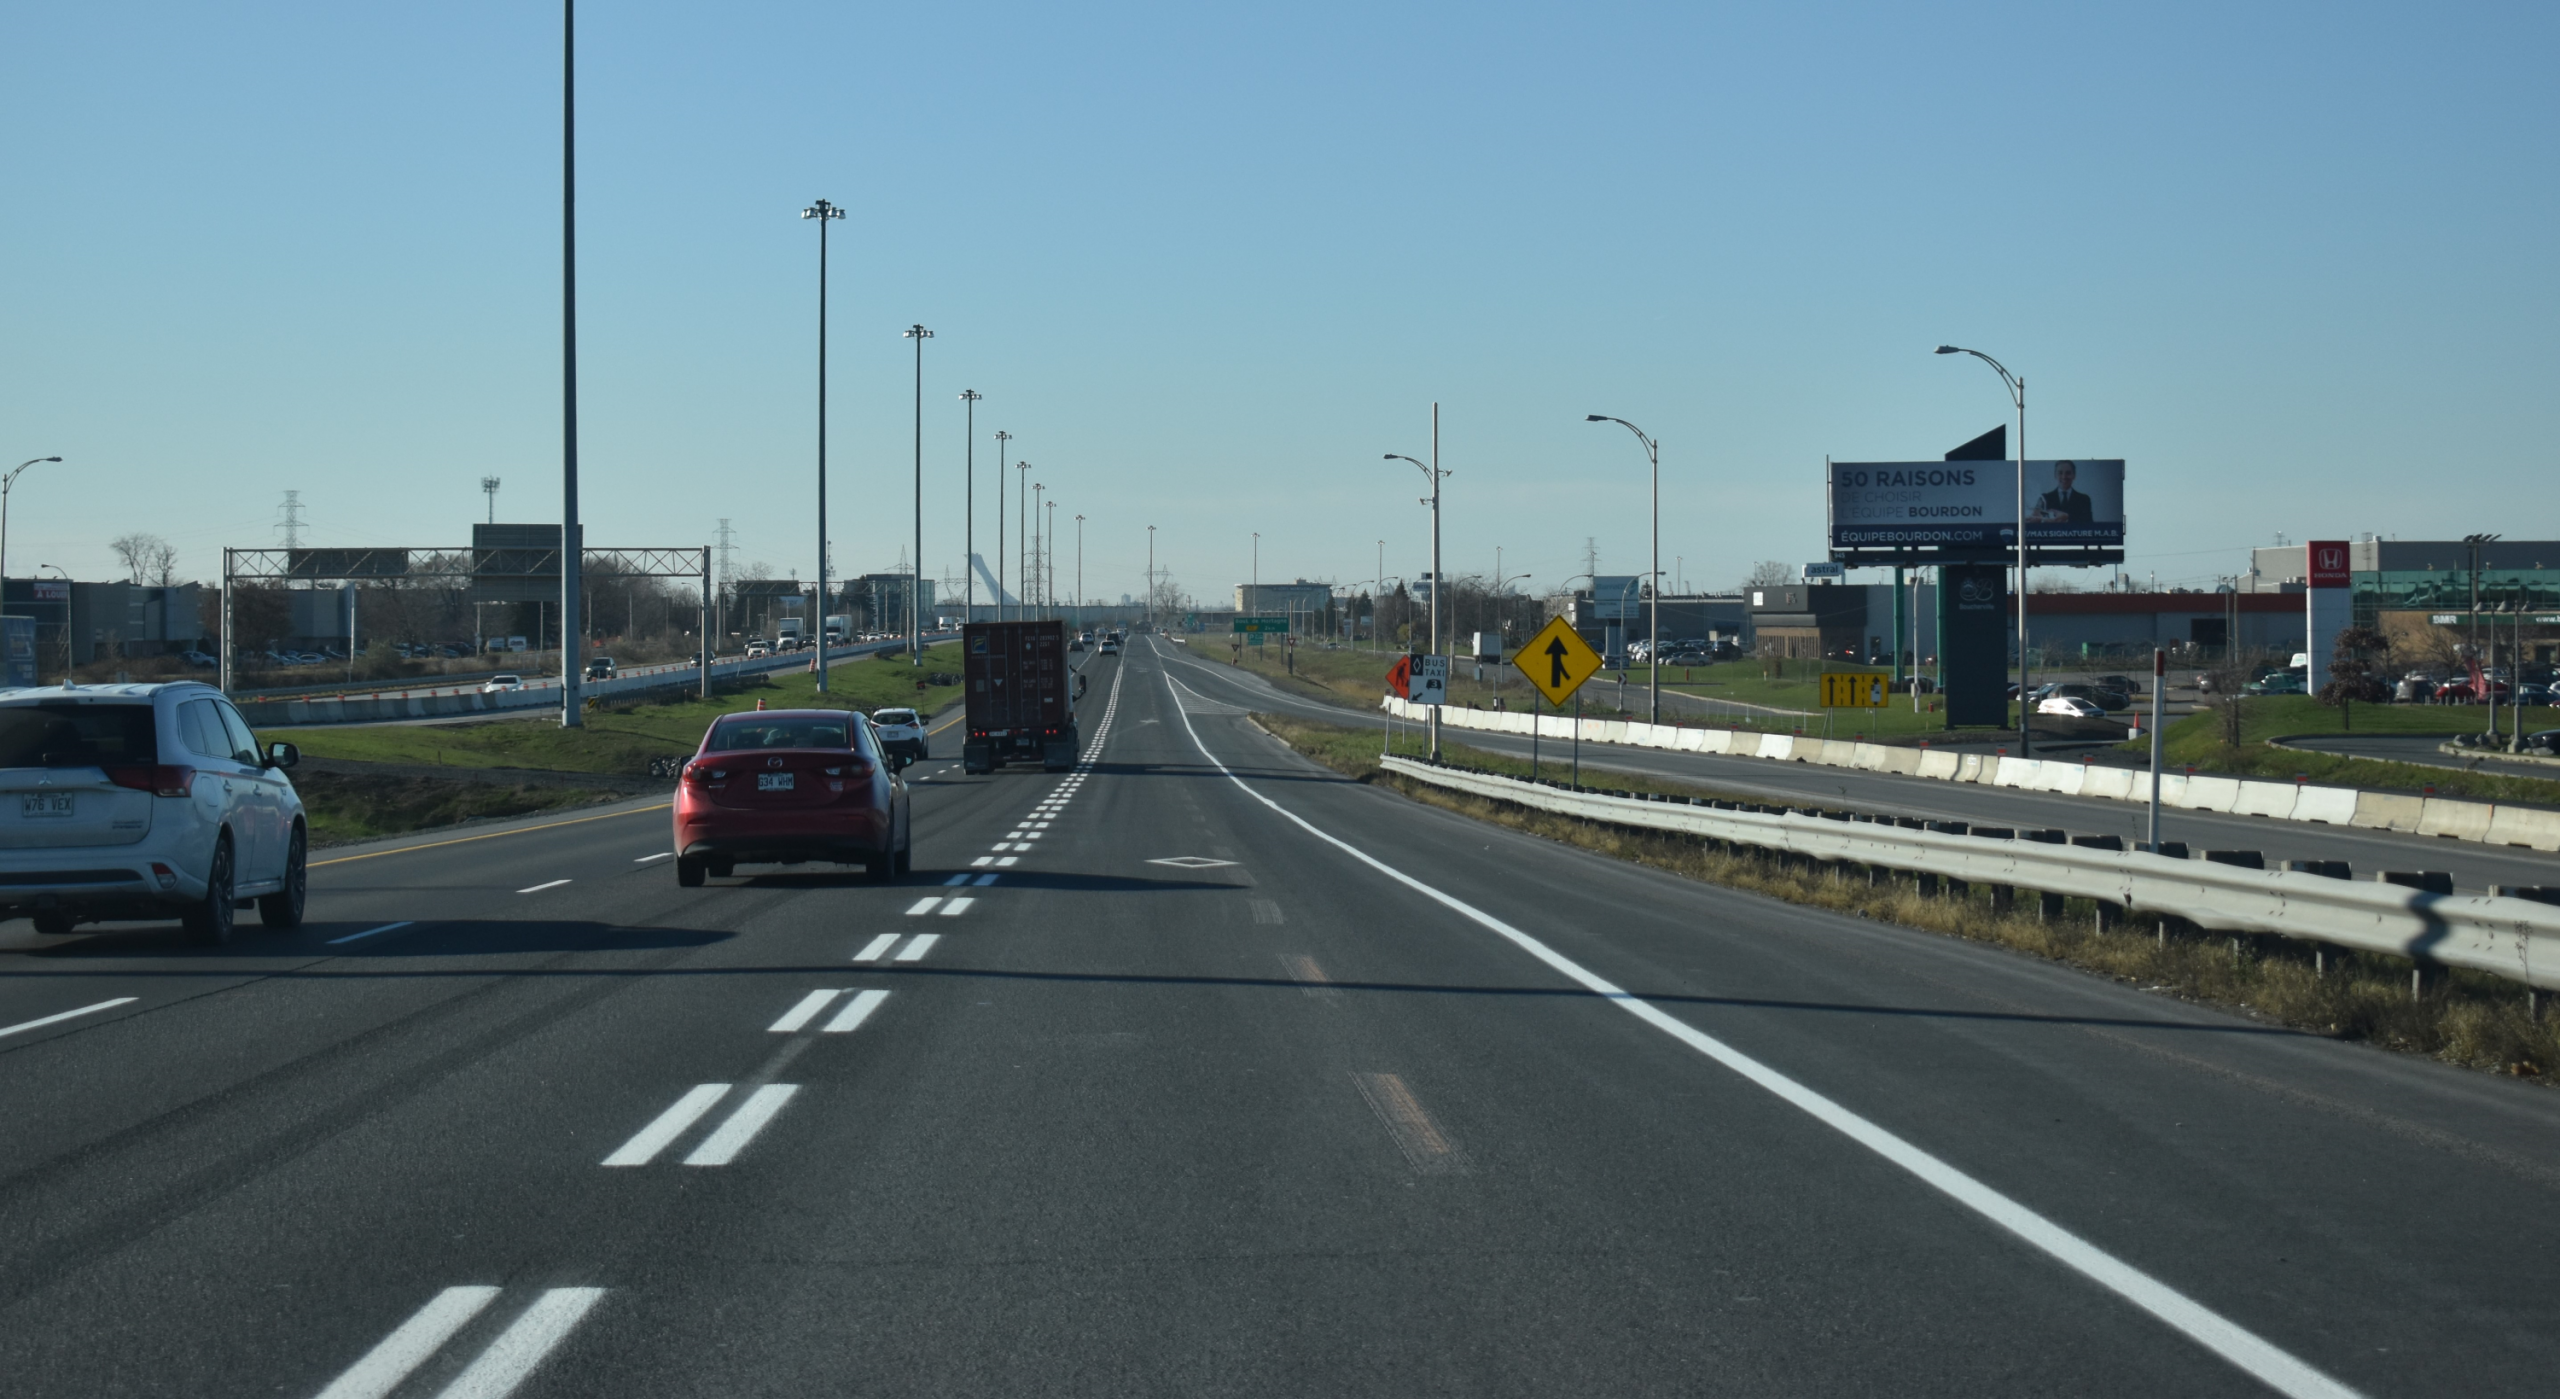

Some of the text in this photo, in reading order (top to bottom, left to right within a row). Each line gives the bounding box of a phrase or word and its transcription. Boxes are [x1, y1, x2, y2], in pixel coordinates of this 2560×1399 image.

[1841, 469, 1975, 487] 50 RAISONS
[1841, 491, 1921, 503] DE CHOISIR
[1841, 505, 1983, 519] L'ÉQUIPE BOURDON
[1841, 530, 1983, 542] ÉQUIPEBOURDON.COM
[2017, 530, 2048, 538] /MAX
[2049, 530, 2093, 538] SIGNATURE
[1811, 565, 1839, 574] astral
[2432, 615, 2457, 624] BMR
[1425, 658, 1445, 667] BUS
[1425, 669, 1445, 677] TAXI
[758, 777, 774, 787] G34
[25, 797, 71, 811] W76 VEX
